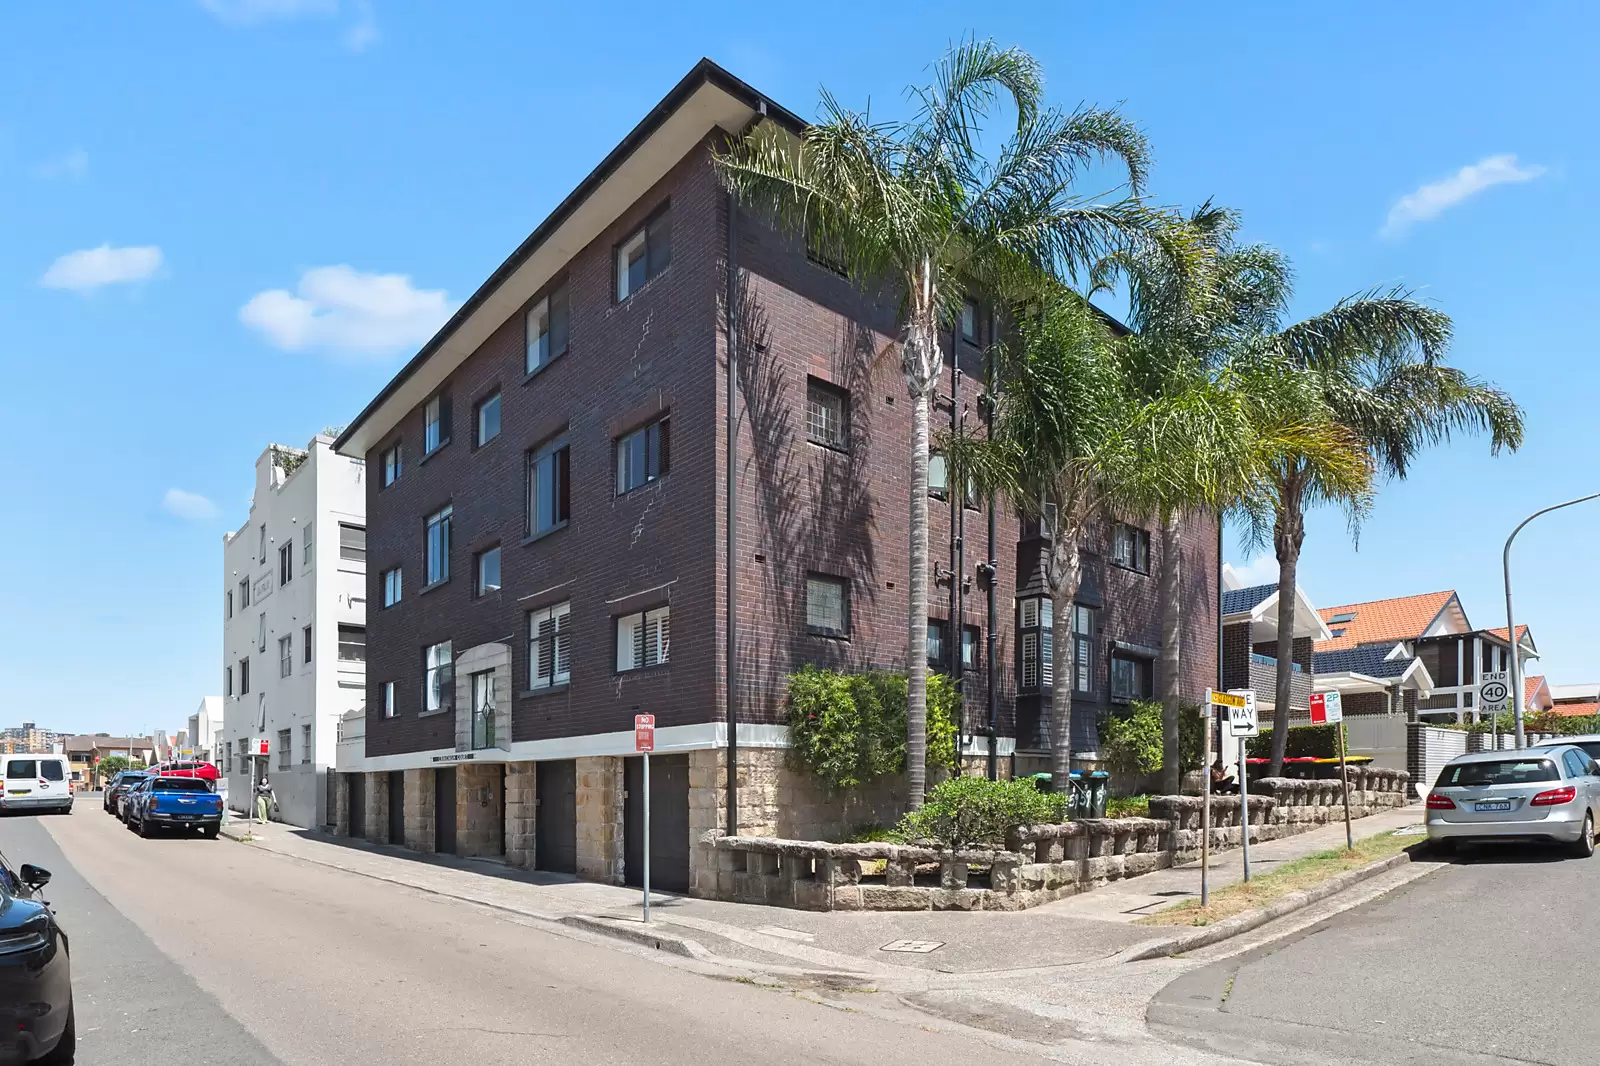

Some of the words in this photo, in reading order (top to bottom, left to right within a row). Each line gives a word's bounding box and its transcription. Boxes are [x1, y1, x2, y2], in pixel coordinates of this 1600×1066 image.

[1482, 673, 1506, 681] END
[1484, 687, 1504, 697] 40
[1326, 693, 1339, 702] 2P
[1481, 704, 1507, 712] AREA
[1232, 708, 1253, 718] WAY
